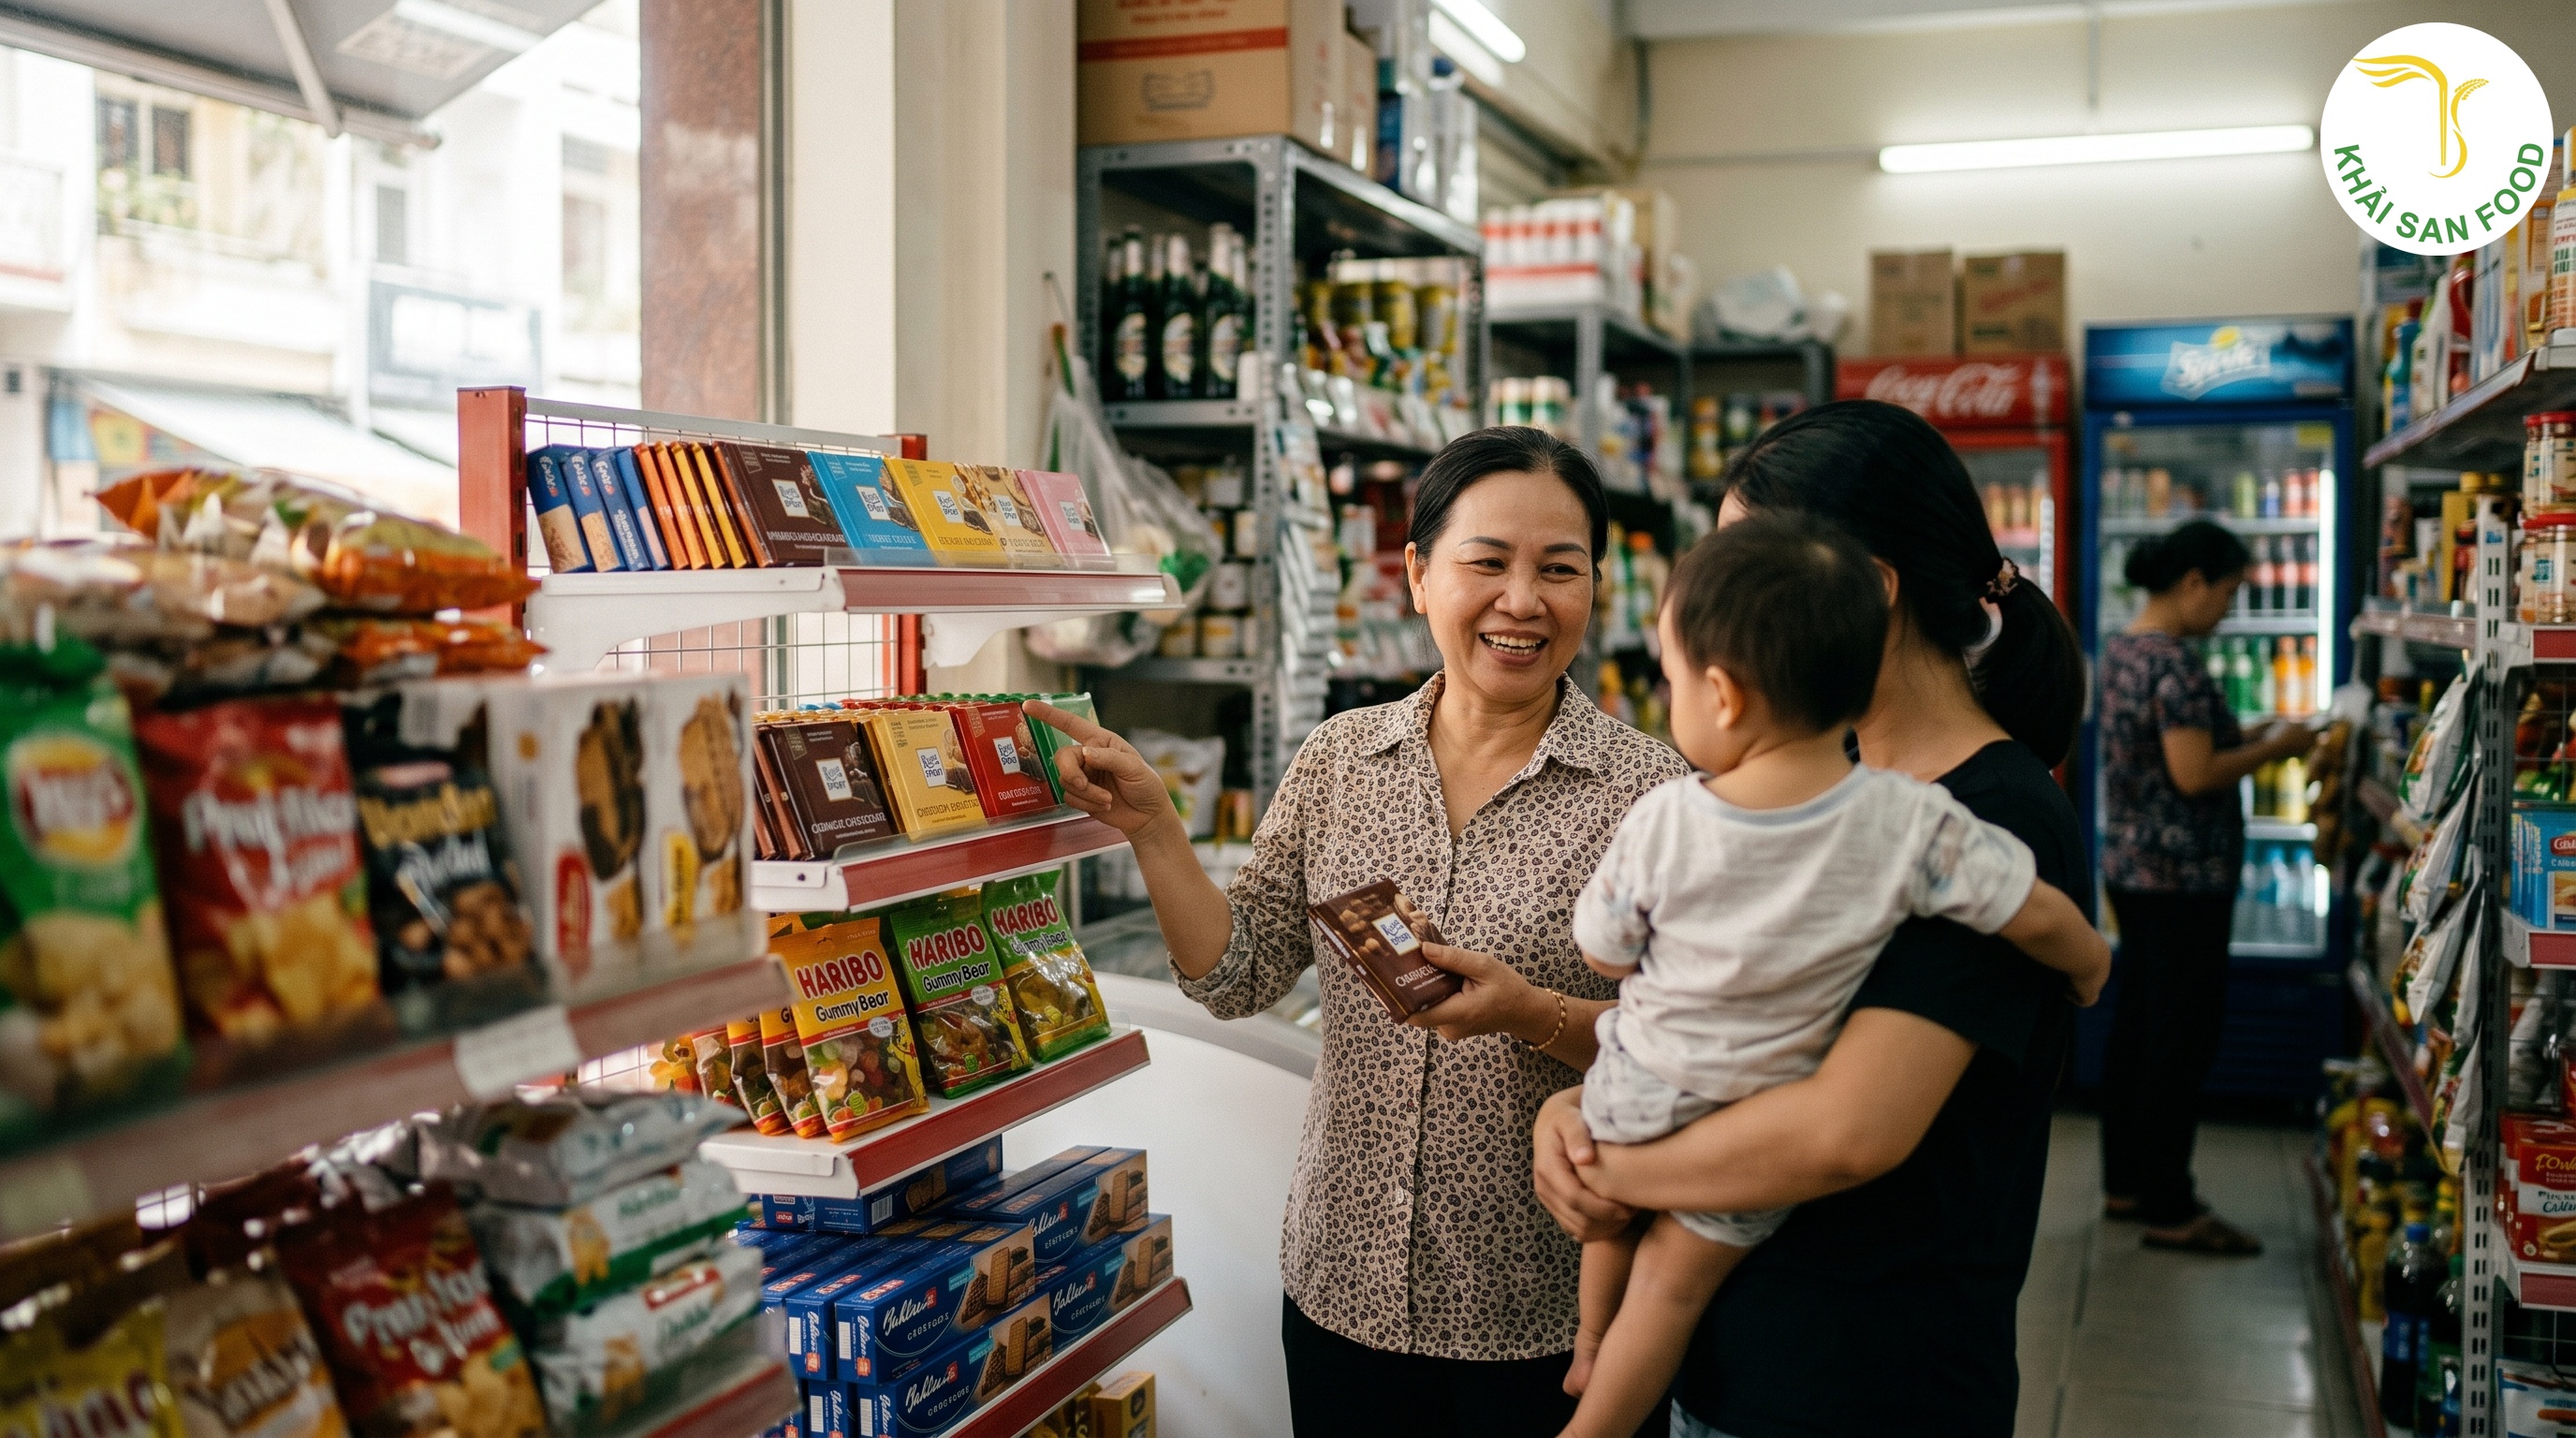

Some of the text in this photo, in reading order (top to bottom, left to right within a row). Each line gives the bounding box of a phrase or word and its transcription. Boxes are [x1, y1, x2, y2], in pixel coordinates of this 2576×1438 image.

[991, 896, 1060, 939] HARIBO
[907, 923, 987, 972] HARIBO
[796, 950, 885, 1001] HARIBO
